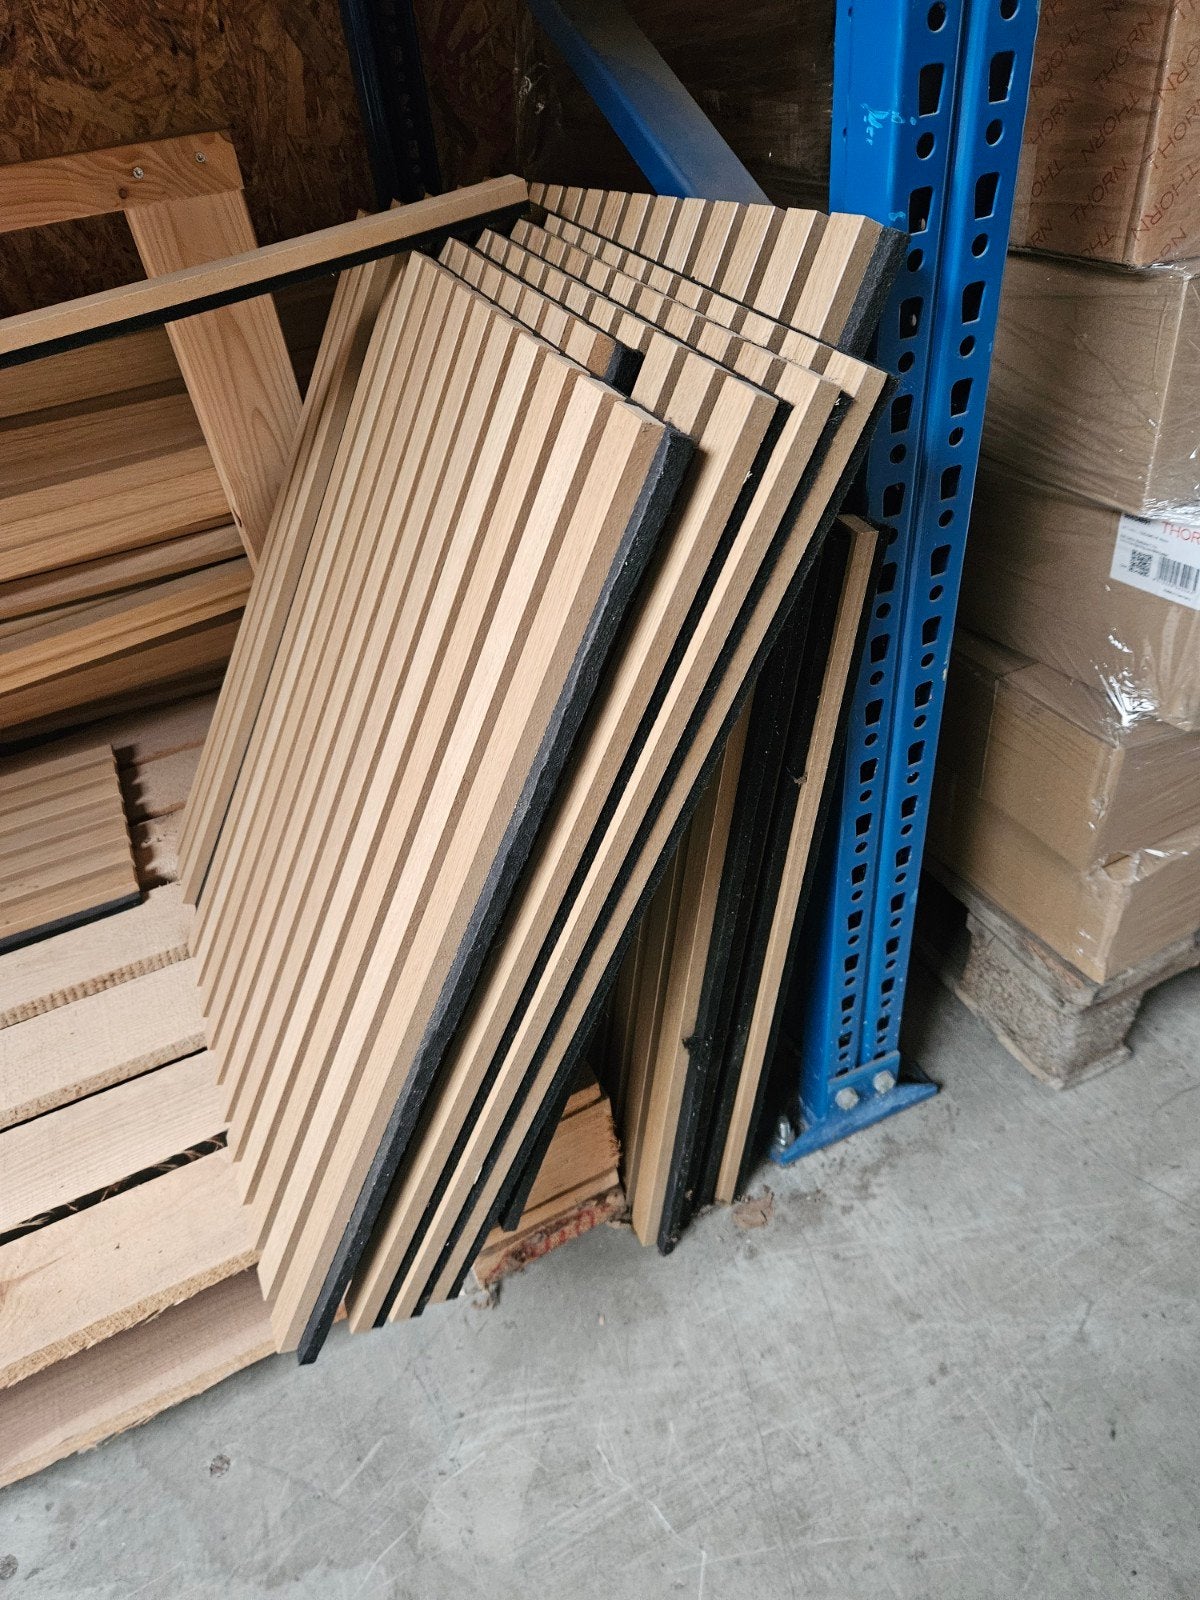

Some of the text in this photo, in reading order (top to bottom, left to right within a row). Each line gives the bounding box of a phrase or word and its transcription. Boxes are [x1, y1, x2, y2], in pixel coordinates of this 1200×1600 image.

[1092, 11, 1154, 92] THORN
[1081, 91, 1139, 163] THORN
[1142, 98, 1200, 170] THOR
[1069, 158, 1128, 225] THORN
[1131, 164, 1200, 241] THORN
